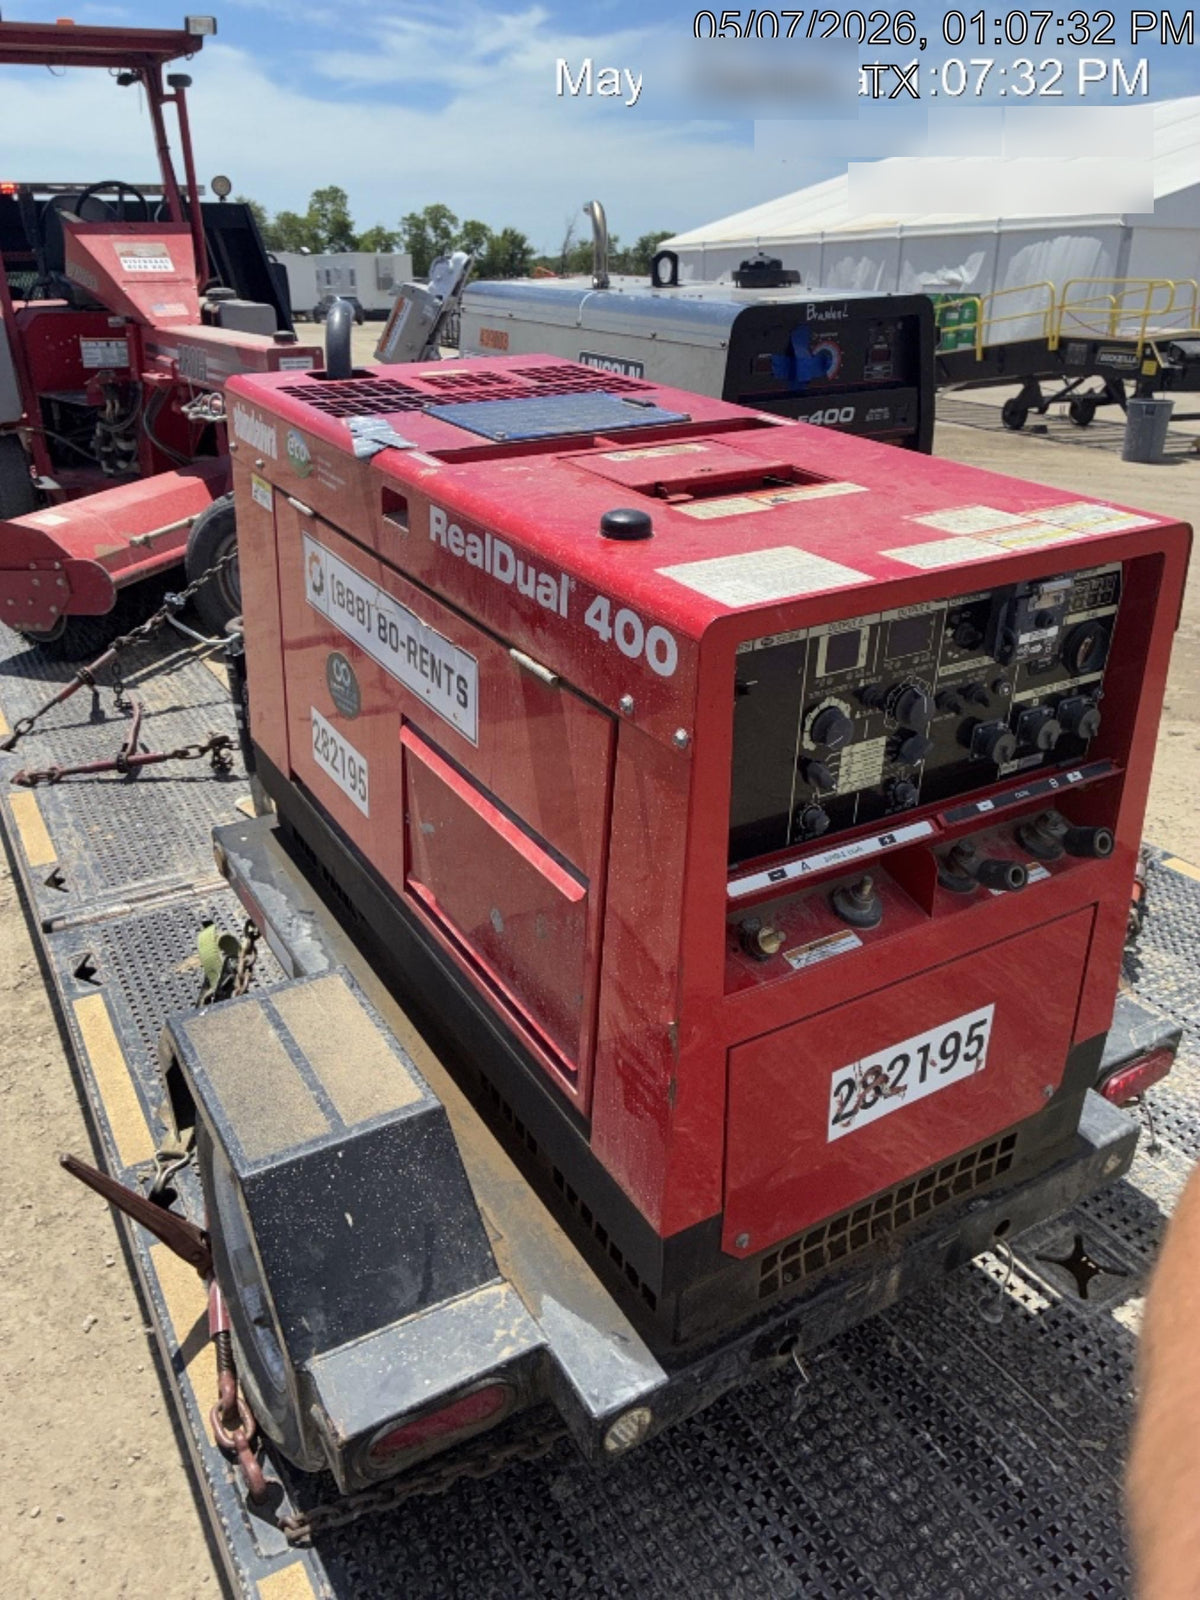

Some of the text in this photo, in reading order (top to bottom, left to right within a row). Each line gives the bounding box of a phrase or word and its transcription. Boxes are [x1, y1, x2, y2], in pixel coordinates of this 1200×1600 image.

[330, 573, 373, 634] (888)
[377, 612, 469, 710] 80-RENTS
[429, 504, 570, 619] RealDual
[584, 594, 679, 677] 400
[311, 719, 368, 804] 282195
[800, 860, 812, 872] A
[831, 1017, 988, 1127] 282195
